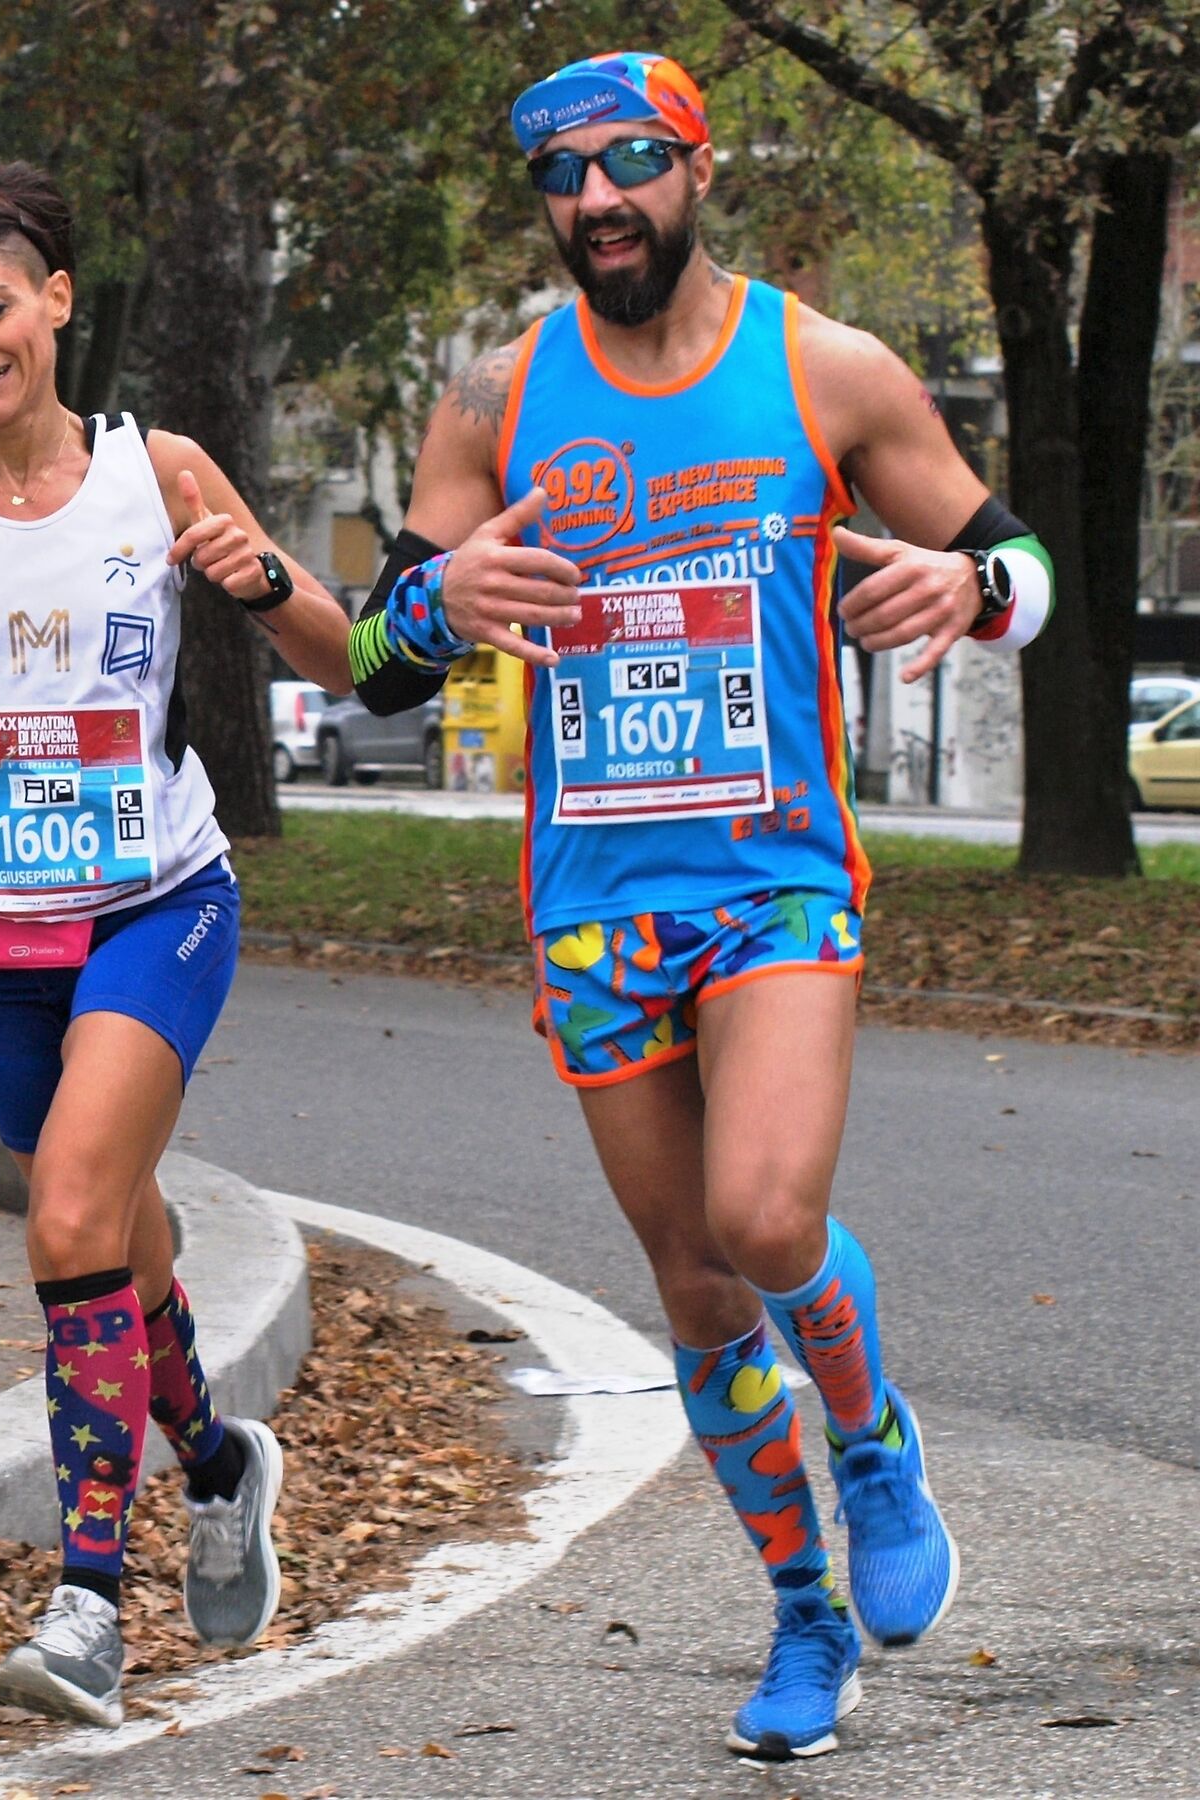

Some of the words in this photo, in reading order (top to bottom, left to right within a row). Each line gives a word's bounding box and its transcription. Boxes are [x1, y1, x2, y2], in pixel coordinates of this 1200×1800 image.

[647, 475, 675, 497] THE
[678, 464, 713, 488] NEW
[716, 456, 786, 479] RUNNING
[647, 478, 757, 523] EXPERIENCE
[552, 508, 617, 535] RUNNING
[601, 598, 623, 614] XX
[623, 592, 681, 612] MARATONA
[637, 606, 686, 624] RAVENNA
[17, 715, 75, 731] MARATONA
[599, 699, 704, 756] 1607
[17, 730, 29, 745] DI
[30, 729, 78, 744] RAVENNA
[18, 743, 44, 756] CITTÀ
[46, 743, 79, 756] D'ARTE
[18, 760, 75, 770] GRIGLIA
[606, 759, 675, 780] ROBERTO
